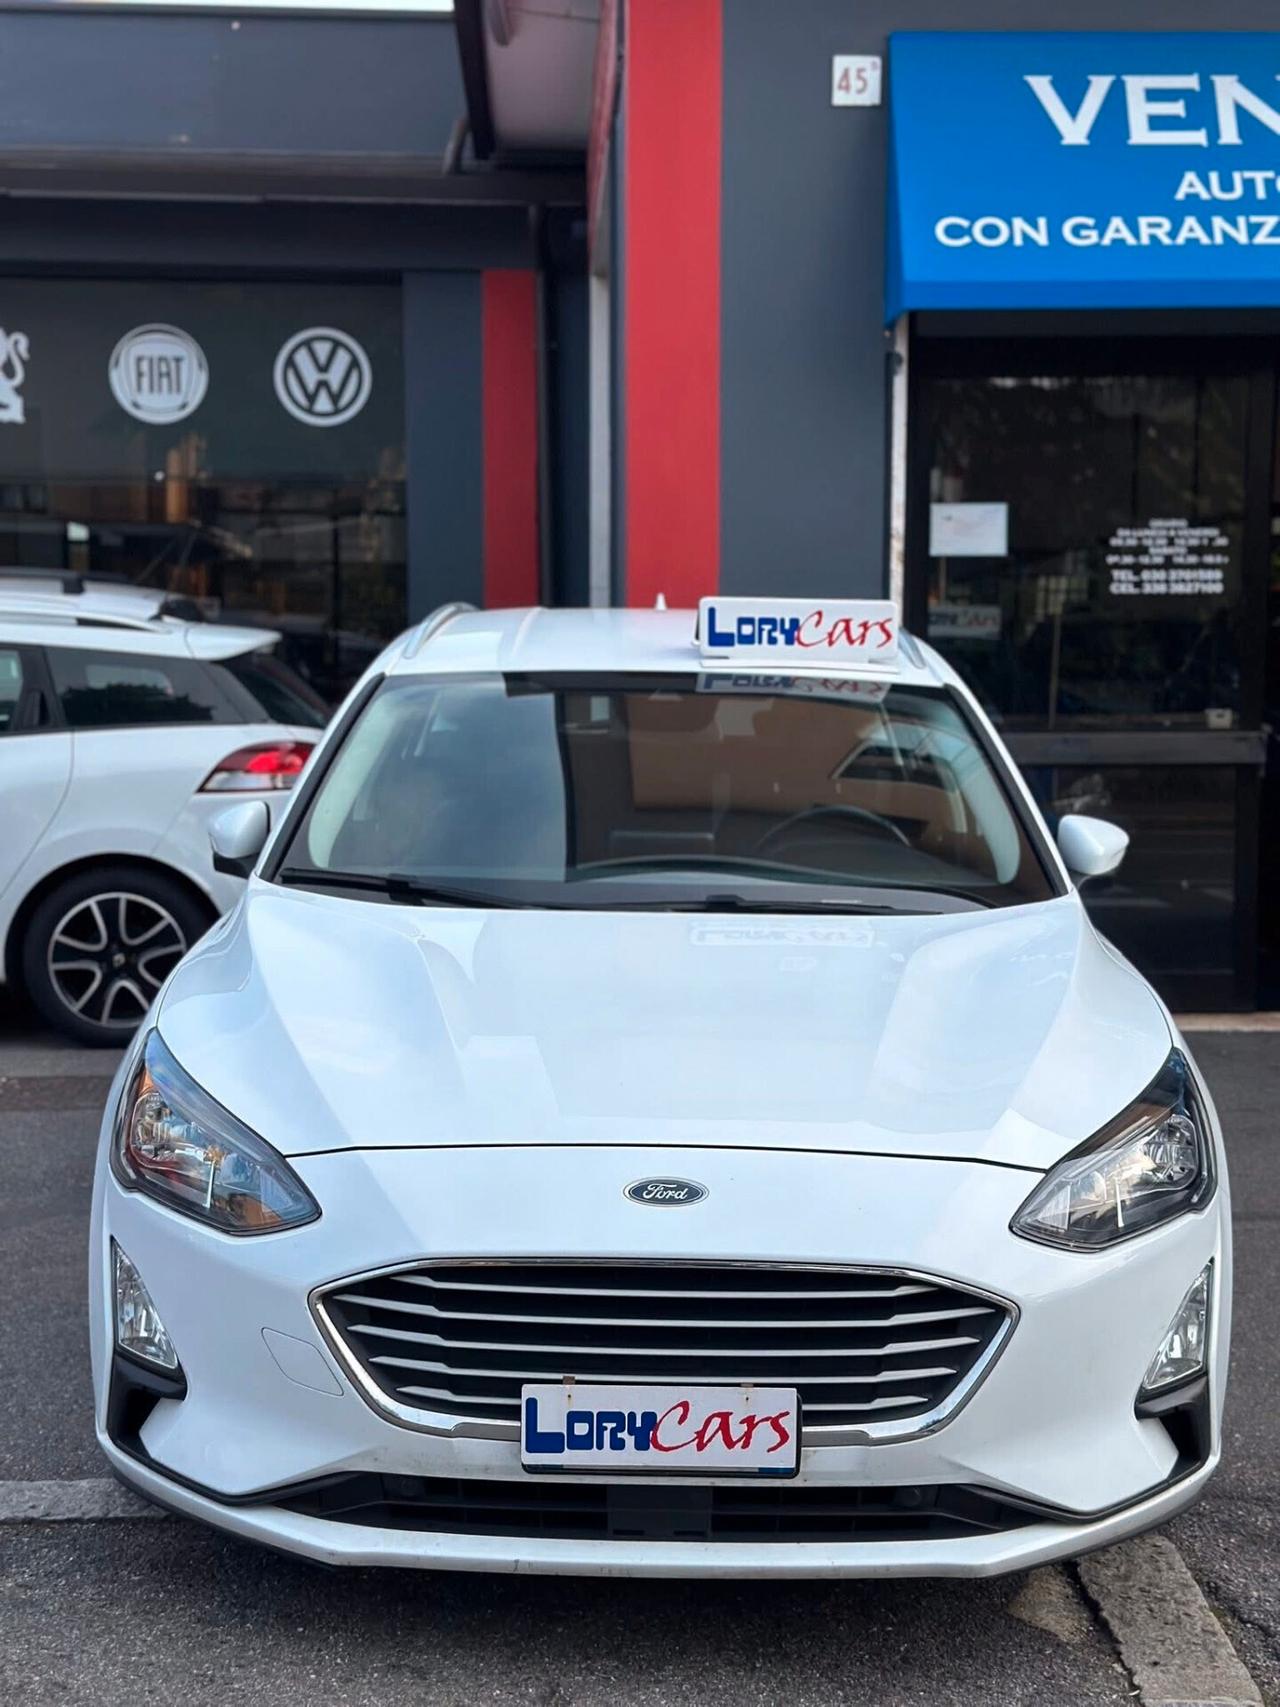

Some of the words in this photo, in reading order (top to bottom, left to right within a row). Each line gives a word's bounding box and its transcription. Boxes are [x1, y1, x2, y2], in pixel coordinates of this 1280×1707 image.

[1174, 171, 1280, 200] AUT
[934, 216, 1049, 247] CON
[1061, 215, 1280, 247] GARANZ
[135, 353, 186, 396] FIAT
[642, 1182, 689, 1200] Ford
